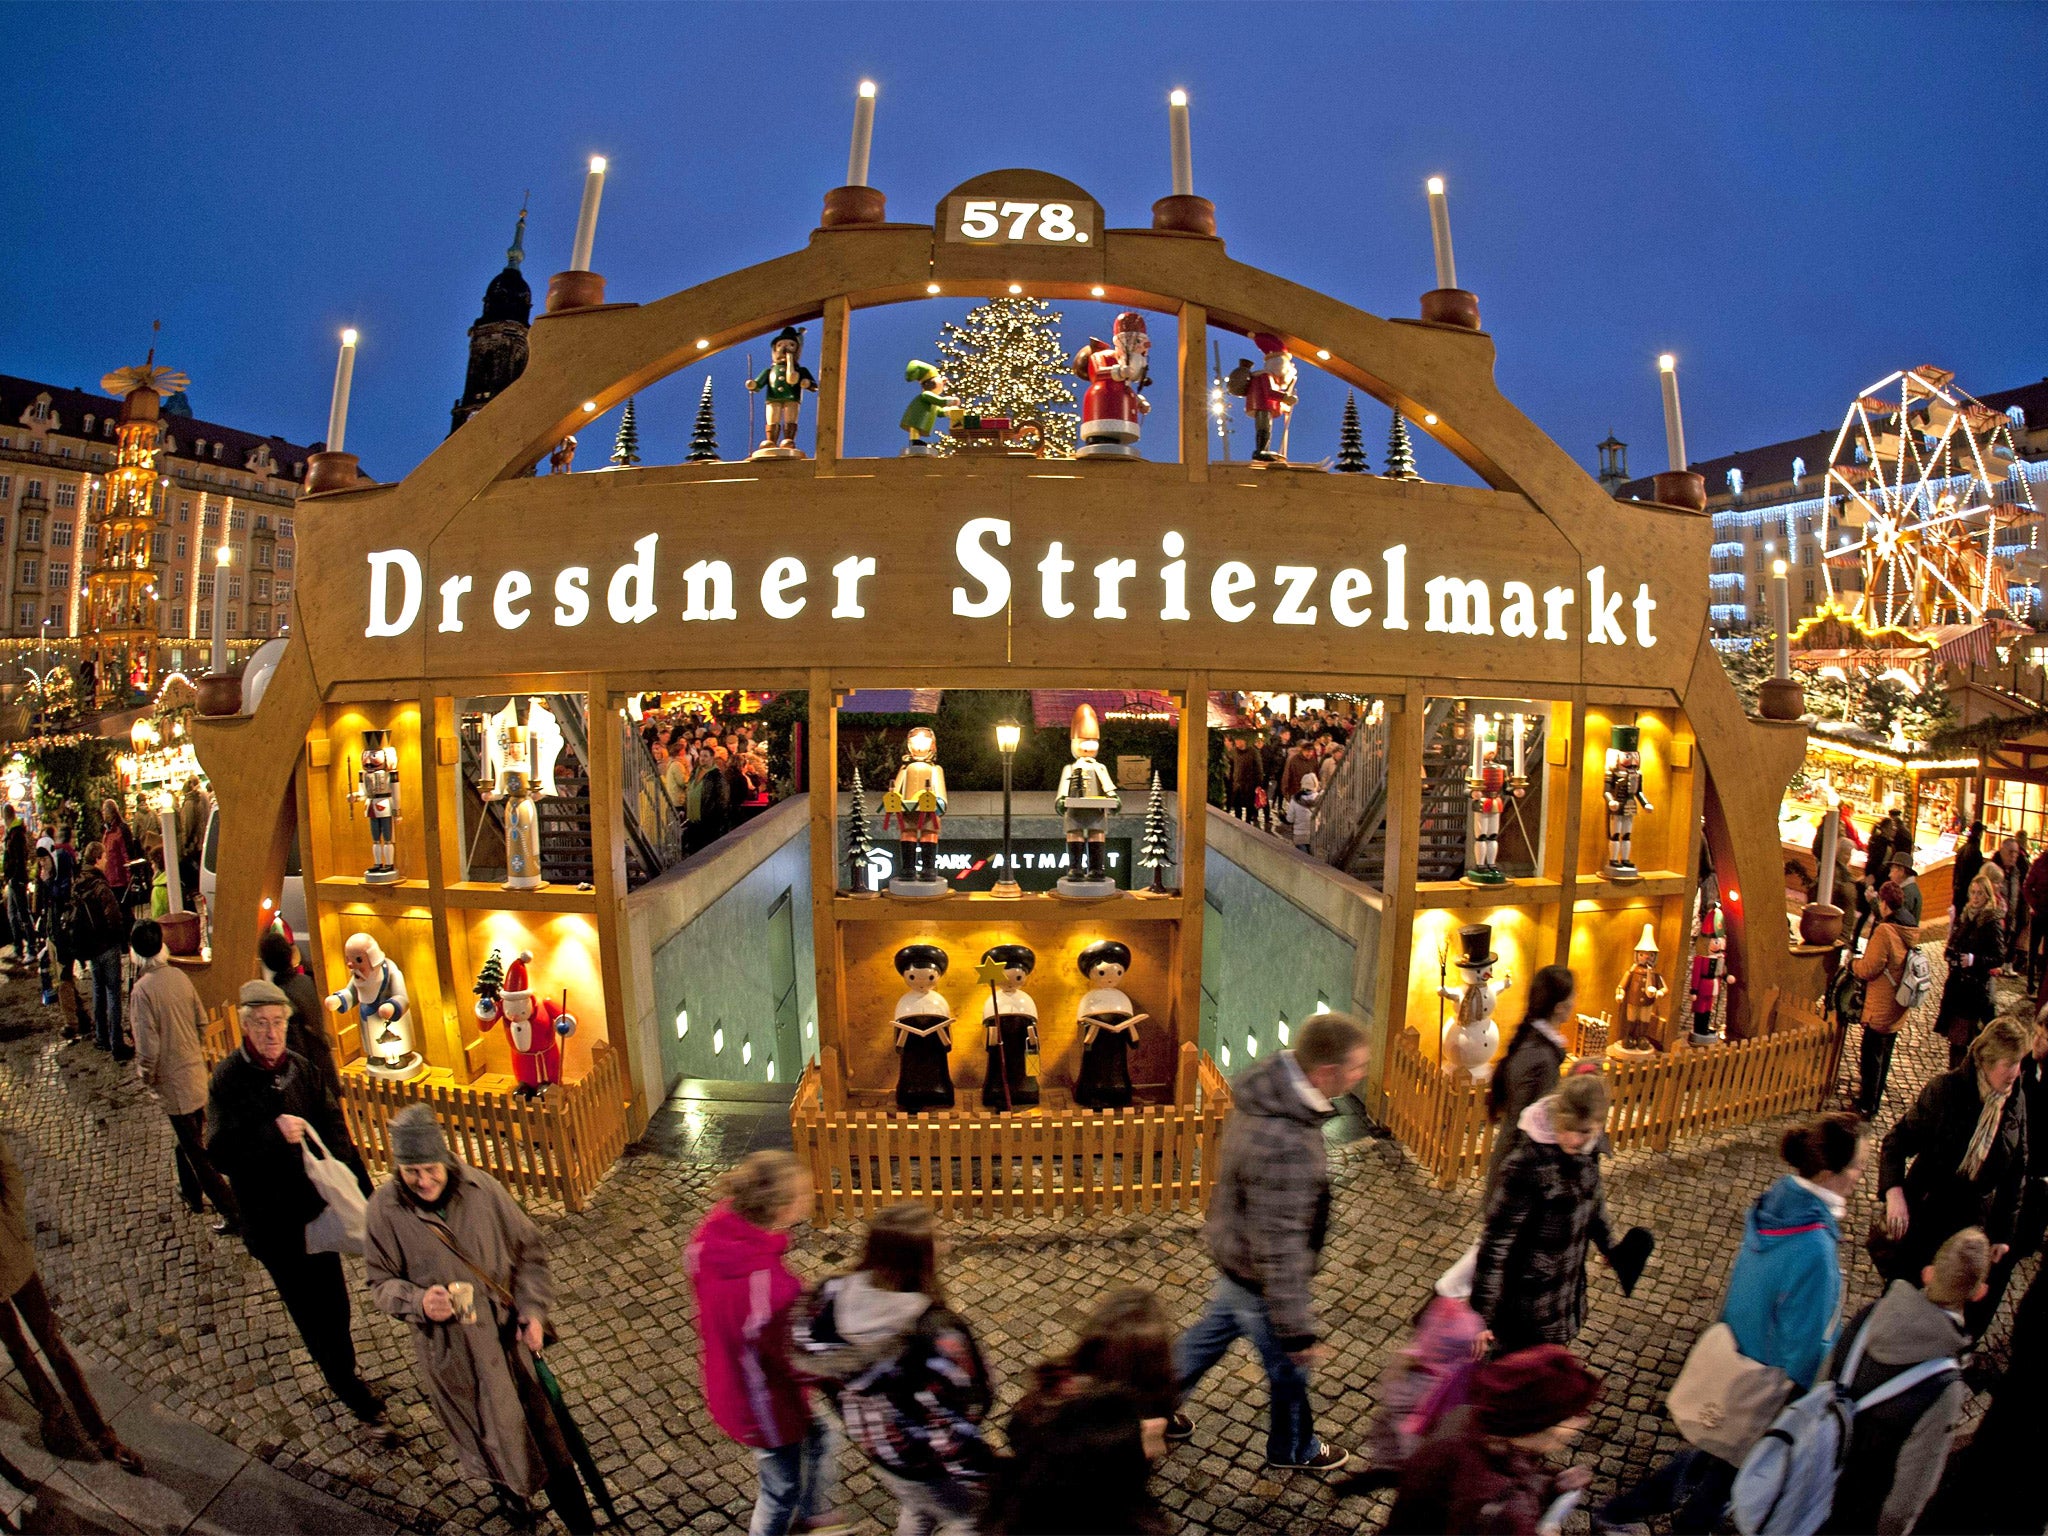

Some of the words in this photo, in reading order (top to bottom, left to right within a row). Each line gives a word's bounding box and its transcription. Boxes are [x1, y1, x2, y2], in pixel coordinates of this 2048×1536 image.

[960, 201, 1089, 243] 578.
[365, 531, 877, 639] Dresdner
[951, 517, 1658, 649] Striezelmarkt
[991, 852, 1120, 869] ALTMART
